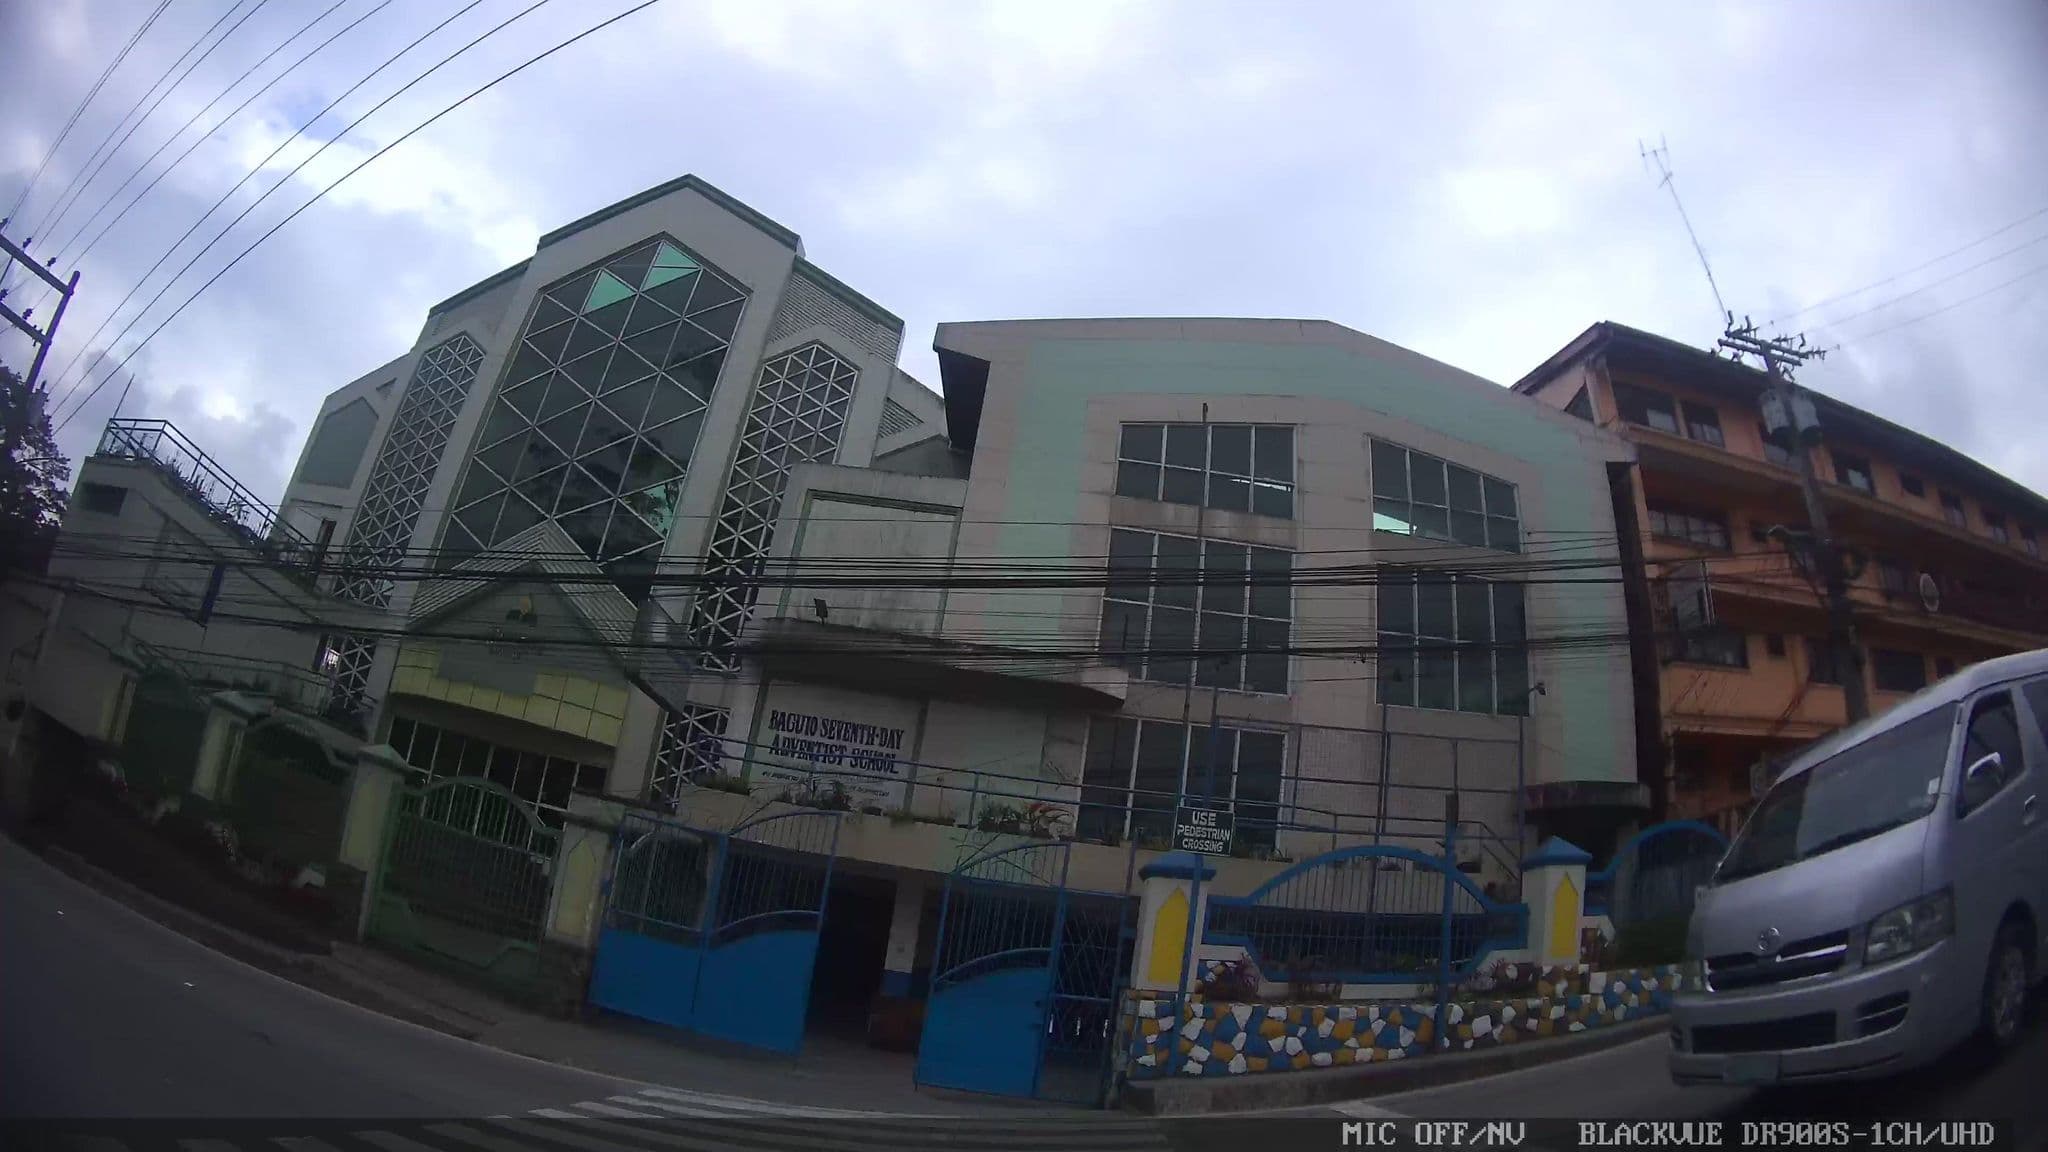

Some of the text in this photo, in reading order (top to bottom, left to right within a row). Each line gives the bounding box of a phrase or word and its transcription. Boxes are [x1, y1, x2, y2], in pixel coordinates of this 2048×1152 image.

[769, 709, 904, 749] BAGUIO SEVENTH-DAY
[769, 735, 899, 774] ADVENTIST SCHOOL
[1192, 811, 1216, 826] USE
[1178, 825, 1231, 840] PEDESTRIAN
[1183, 838, 1223, 852] CROSSING
